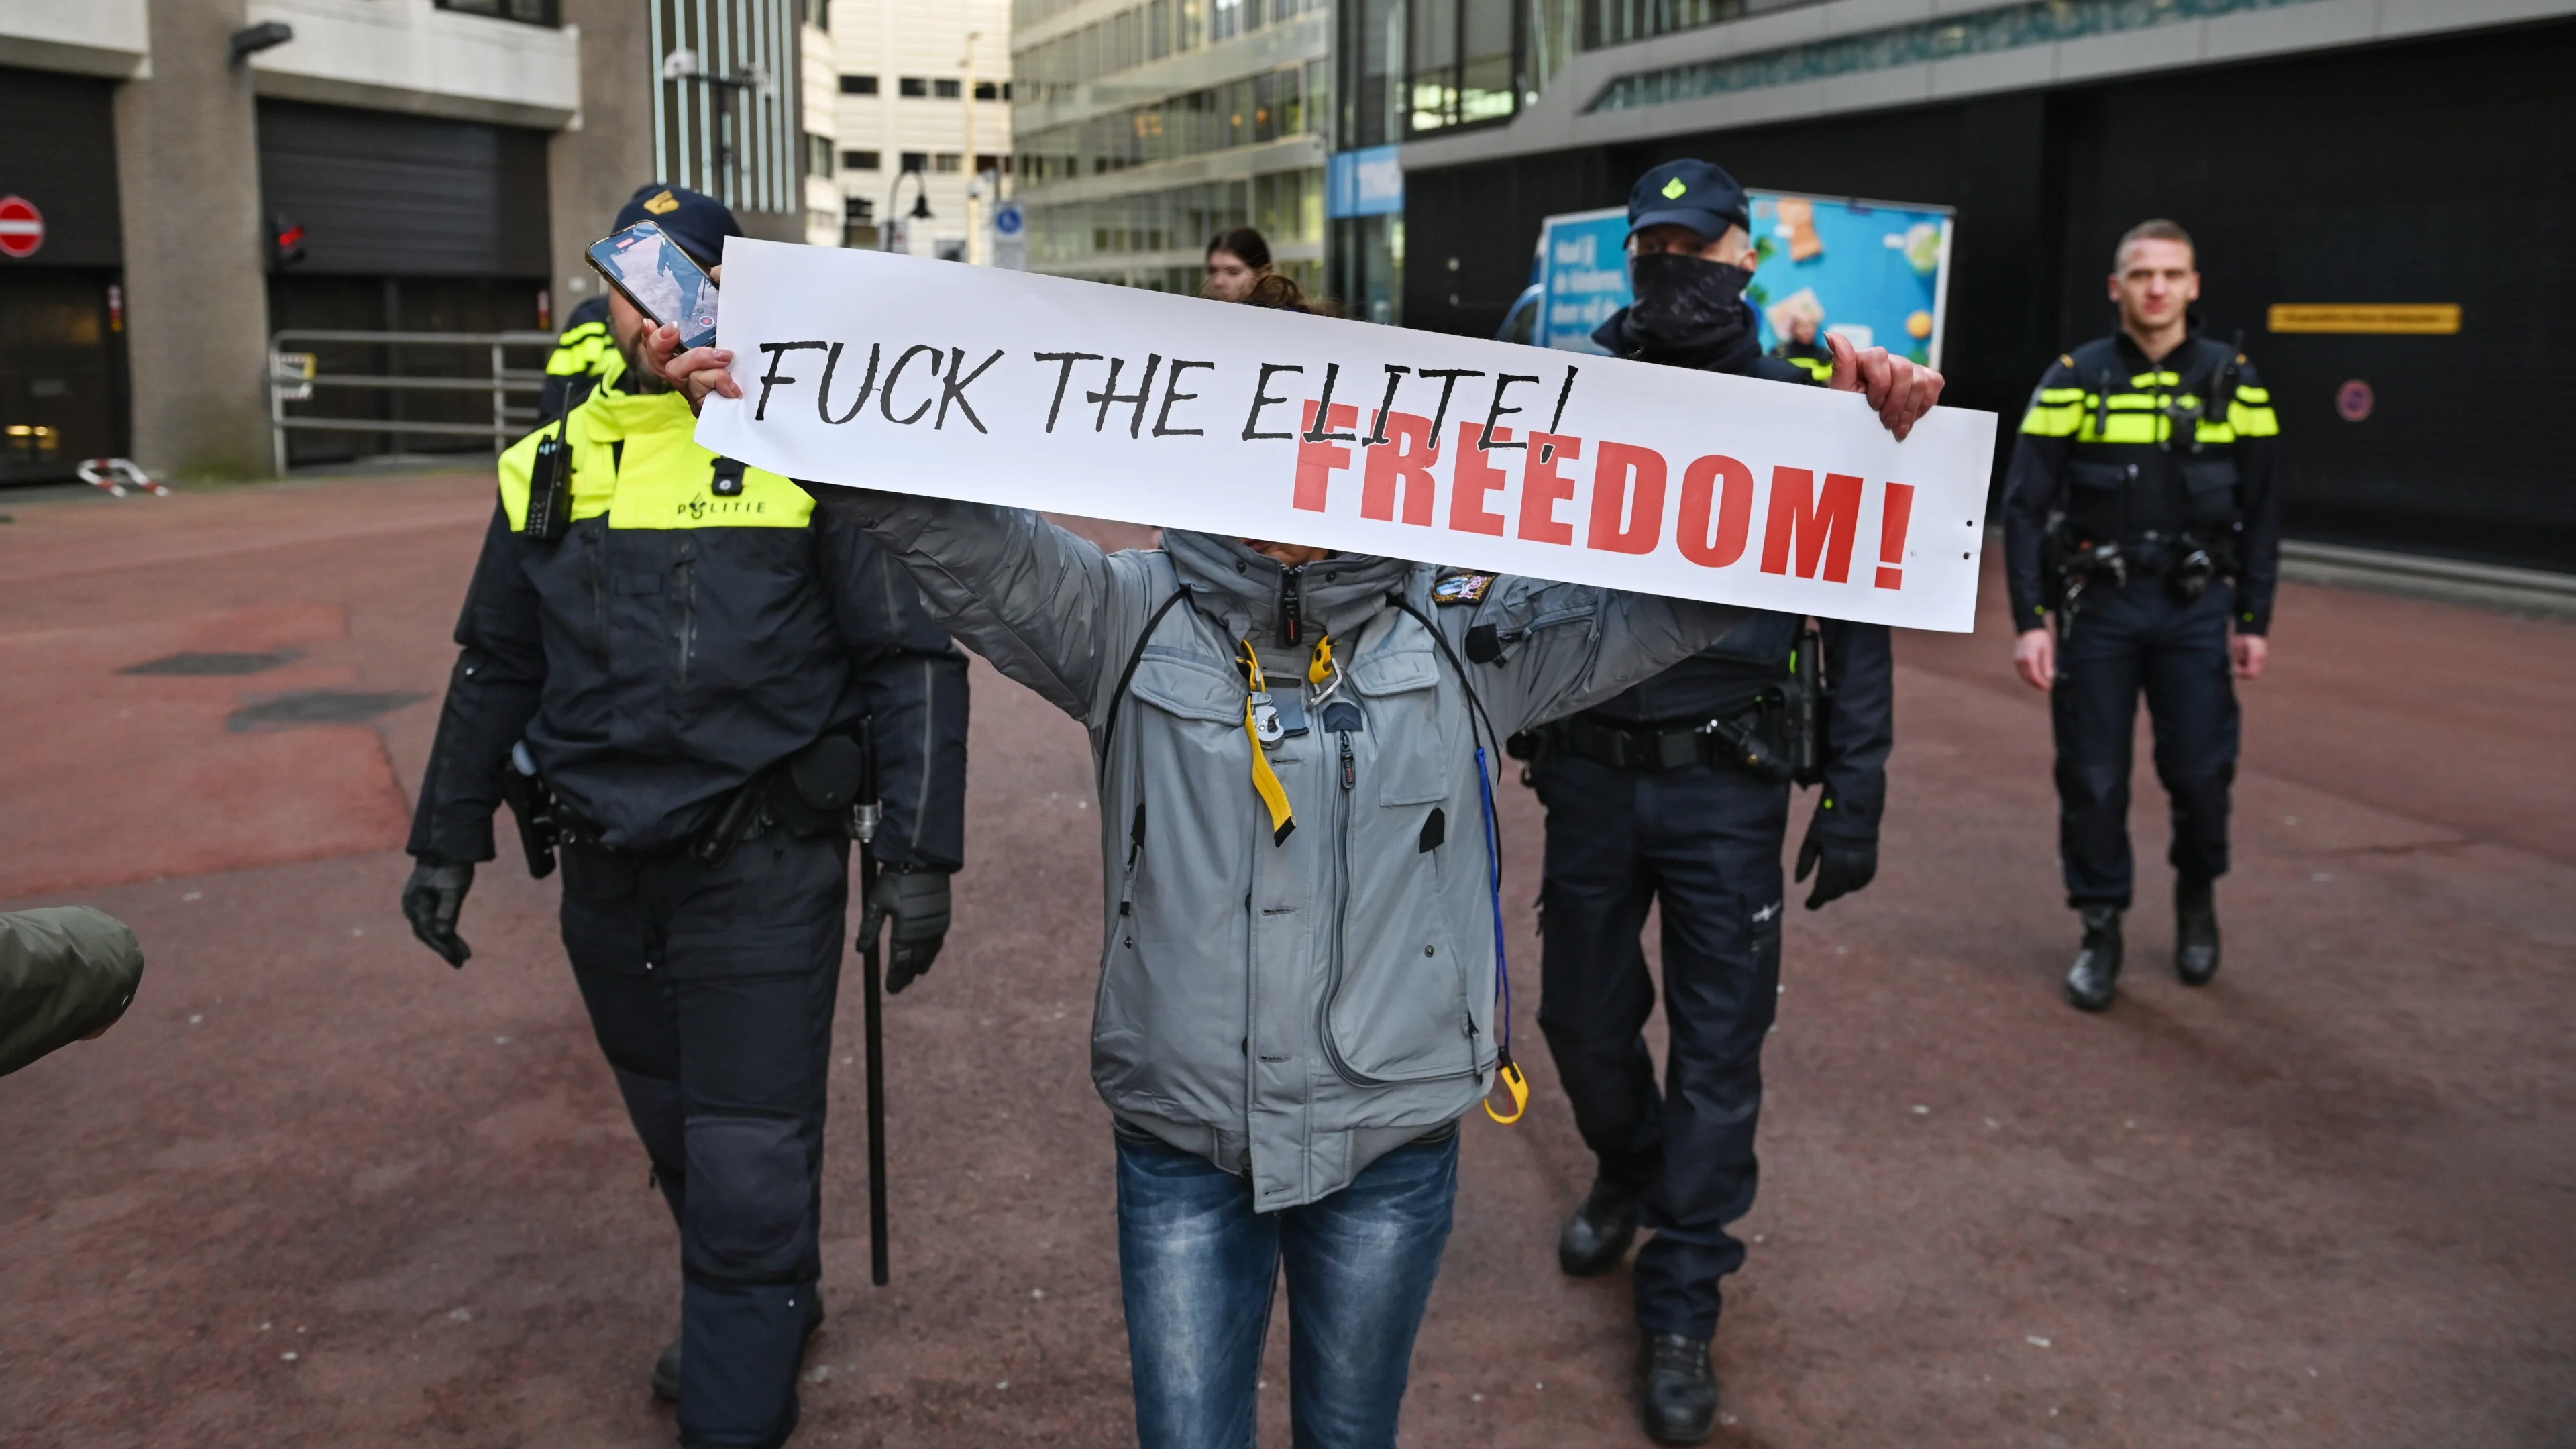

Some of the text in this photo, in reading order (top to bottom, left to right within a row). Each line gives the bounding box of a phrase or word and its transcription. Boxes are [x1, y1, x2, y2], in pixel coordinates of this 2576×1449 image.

[755, 341, 1579, 464] FUCK THE ELITE!
[1292, 398, 1915, 590] FREEDOM!
